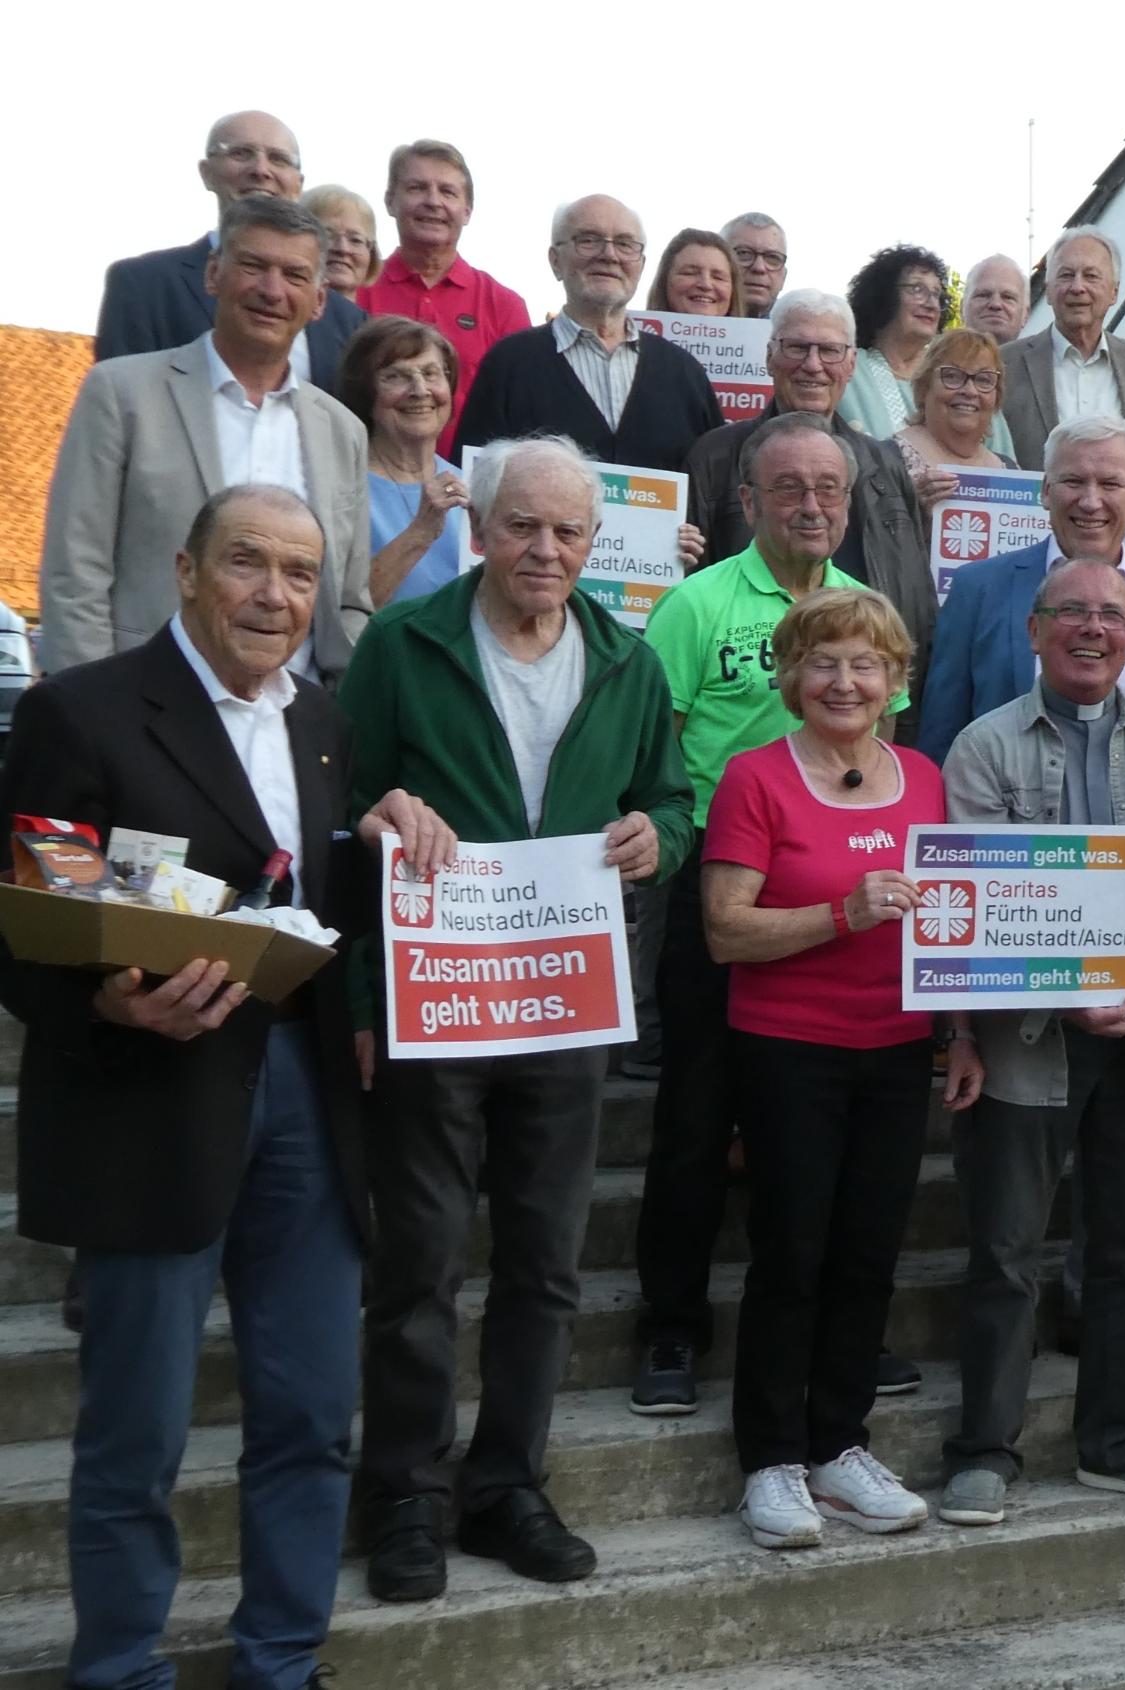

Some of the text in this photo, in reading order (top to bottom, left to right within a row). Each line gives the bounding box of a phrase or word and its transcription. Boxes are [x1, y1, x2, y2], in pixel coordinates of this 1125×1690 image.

[671, 321, 726, 338] Caritas
[716, 345, 744, 357] und
[623, 488, 661, 503] was.
[620, 594, 652, 608] was
[848, 832, 896, 853] esprit
[922, 845, 1123, 867] Zusammen geht was.
[441, 881, 537, 903] Fürth und
[986, 880, 1058, 898] Caritas
[441, 902, 608, 931] Neustadt/Aisch
[985, 904, 1082, 922] Fürth und
[408, 949, 586, 983] Zusammen
[919, 969, 1115, 990] Zusammen geht was.
[421, 994, 575, 1035] geht was.
